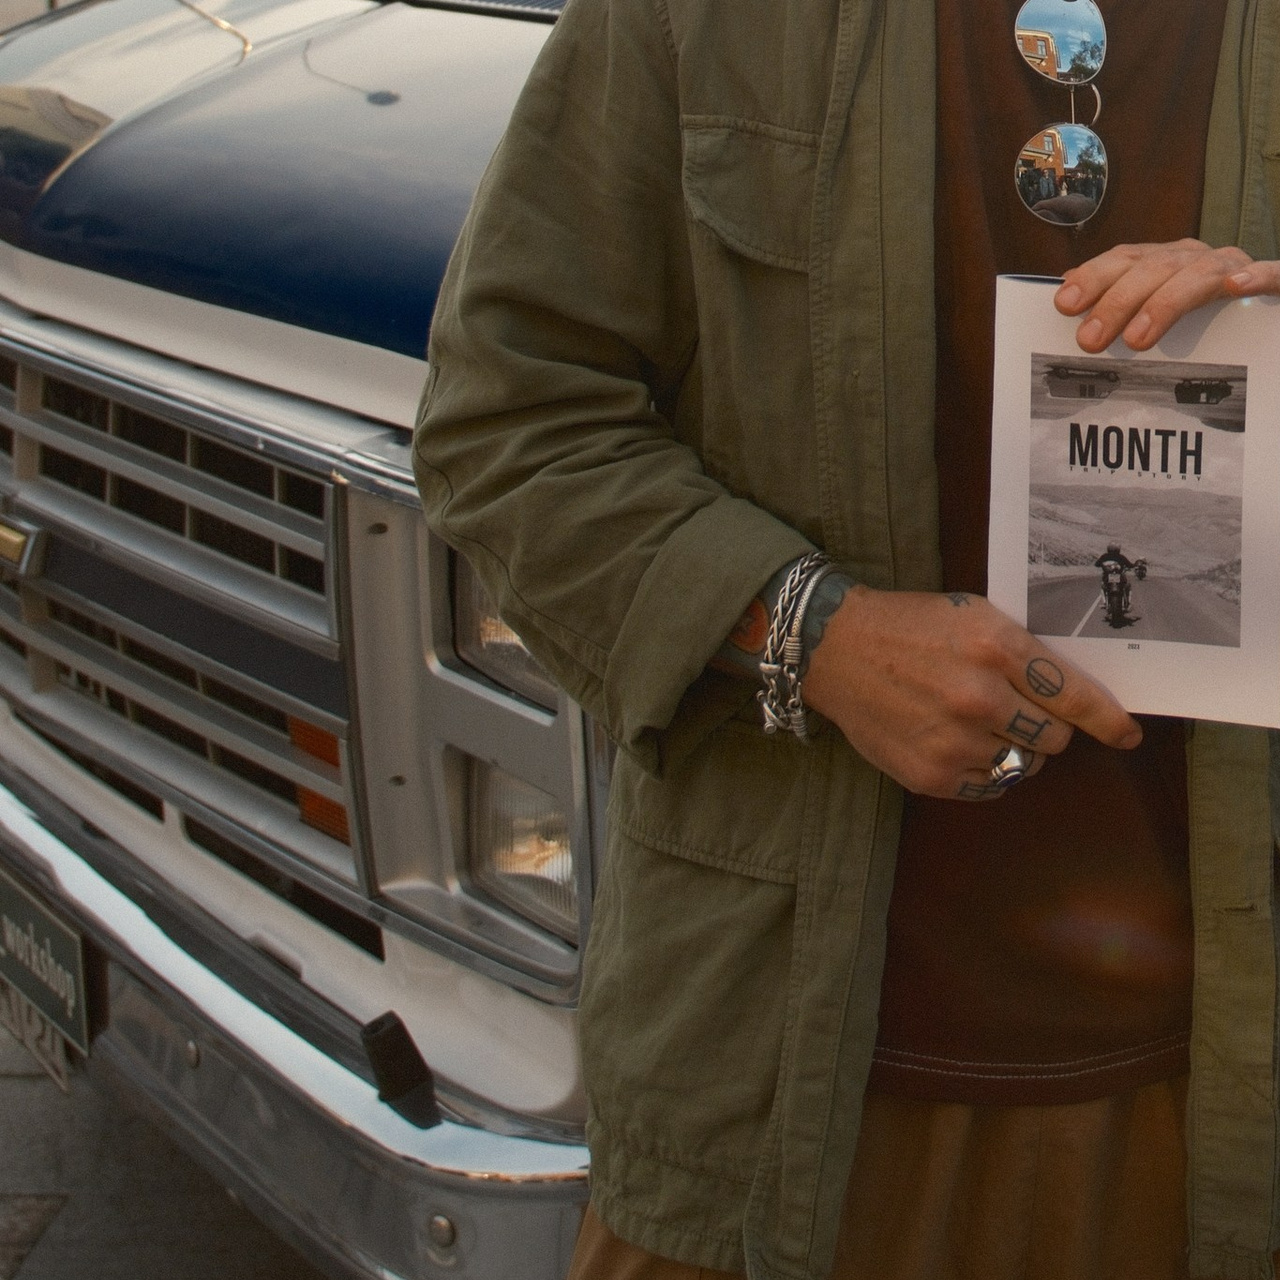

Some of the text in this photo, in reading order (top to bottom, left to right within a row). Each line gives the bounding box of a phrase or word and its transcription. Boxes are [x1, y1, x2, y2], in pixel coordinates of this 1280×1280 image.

[1069, 422, 1203, 475] MONTH
[1069, 466, 1201, 481] TRIP STORY
